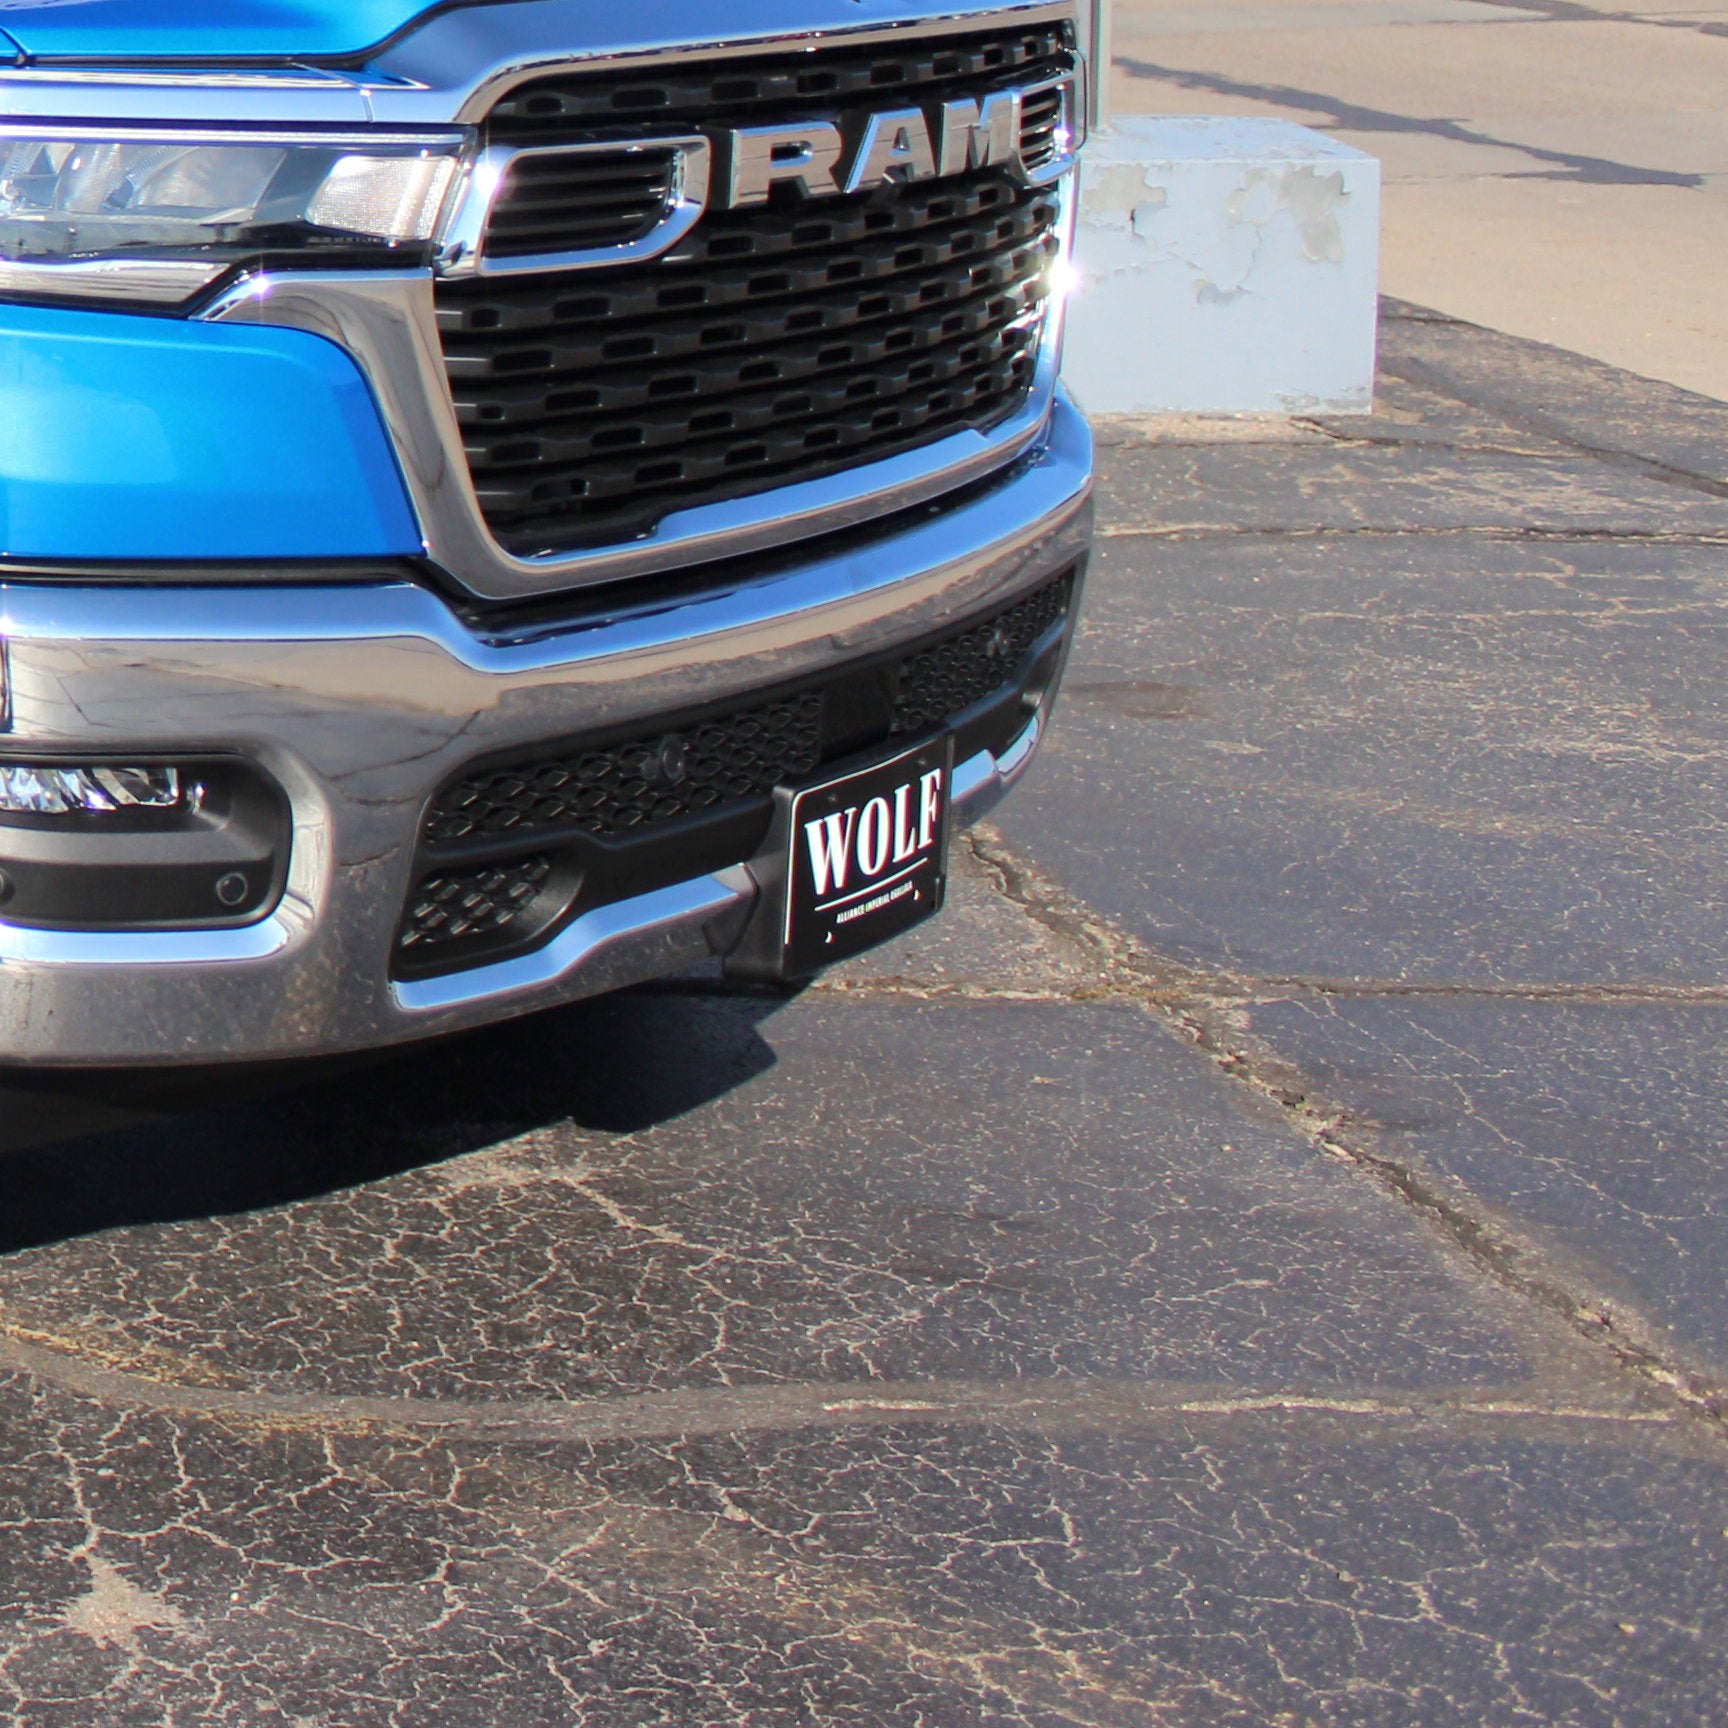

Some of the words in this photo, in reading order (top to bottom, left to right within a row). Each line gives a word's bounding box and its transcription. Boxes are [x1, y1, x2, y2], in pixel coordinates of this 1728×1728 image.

[729, 90, 1020, 210] RAM
[804, 768, 941, 896] WOLF
[836, 903, 865, 924] ALLIANCE
